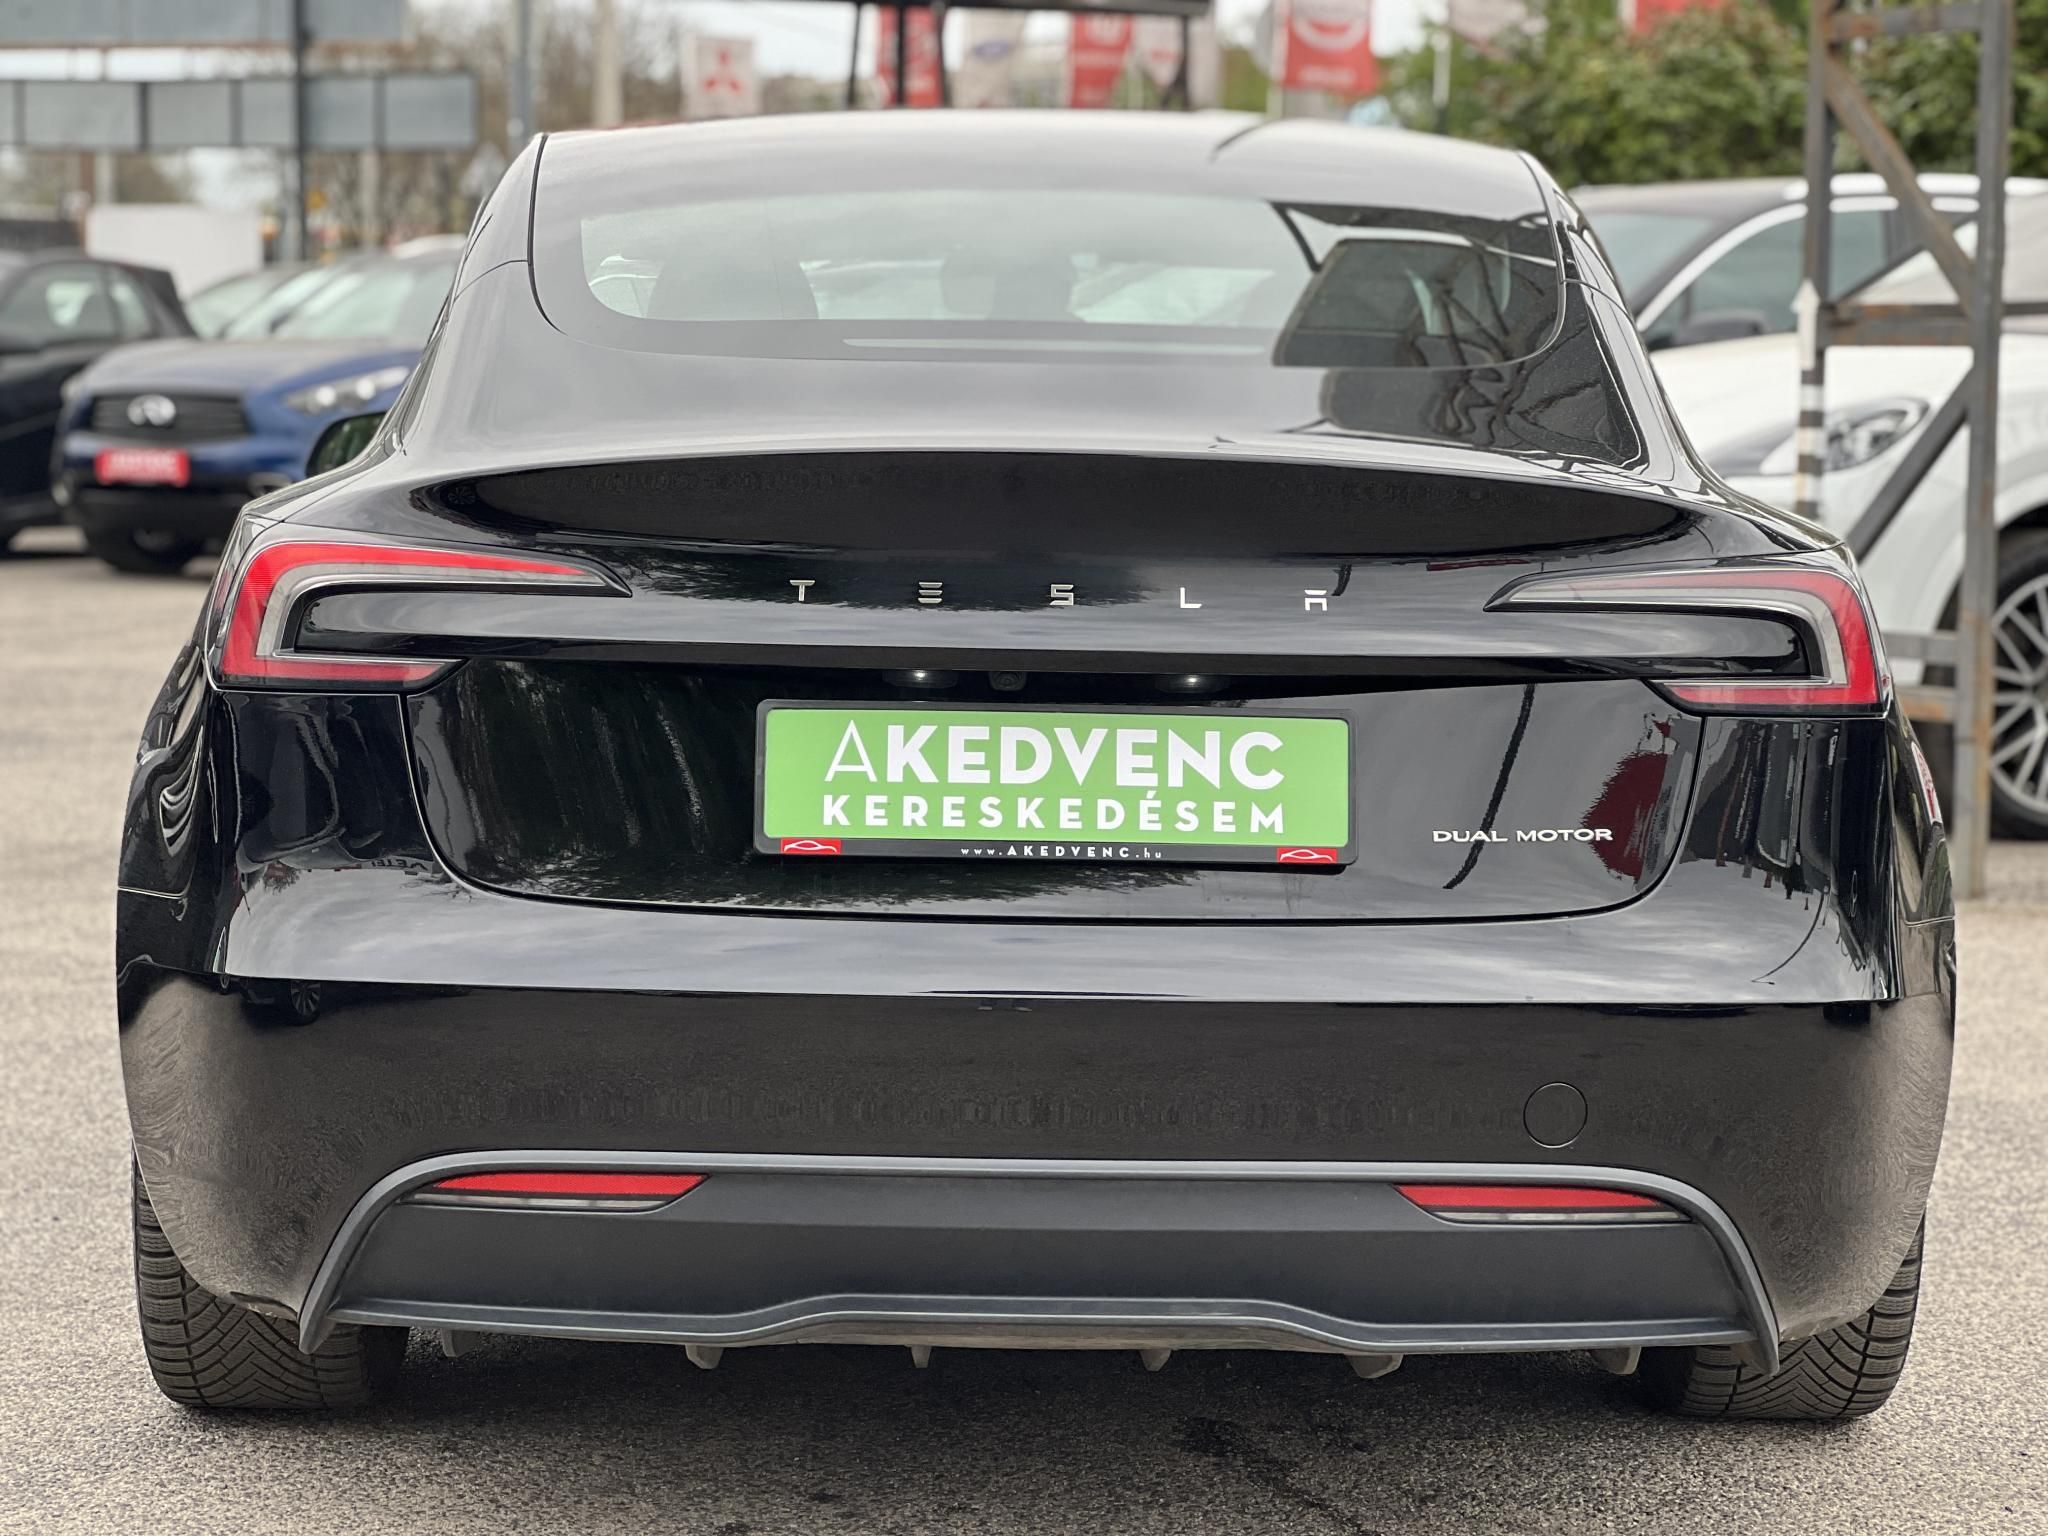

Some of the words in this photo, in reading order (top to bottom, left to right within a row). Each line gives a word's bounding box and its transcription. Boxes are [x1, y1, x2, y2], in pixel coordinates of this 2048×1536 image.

[789, 579, 1328, 612] TESLA
[822, 790, 1285, 834] KERESKEDÉSEM
[1432, 830, 1509, 843] DUAL
[1516, 828, 1614, 842] MOTOR
[960, 845, 1164, 859] www.AKEDVENC.hu
